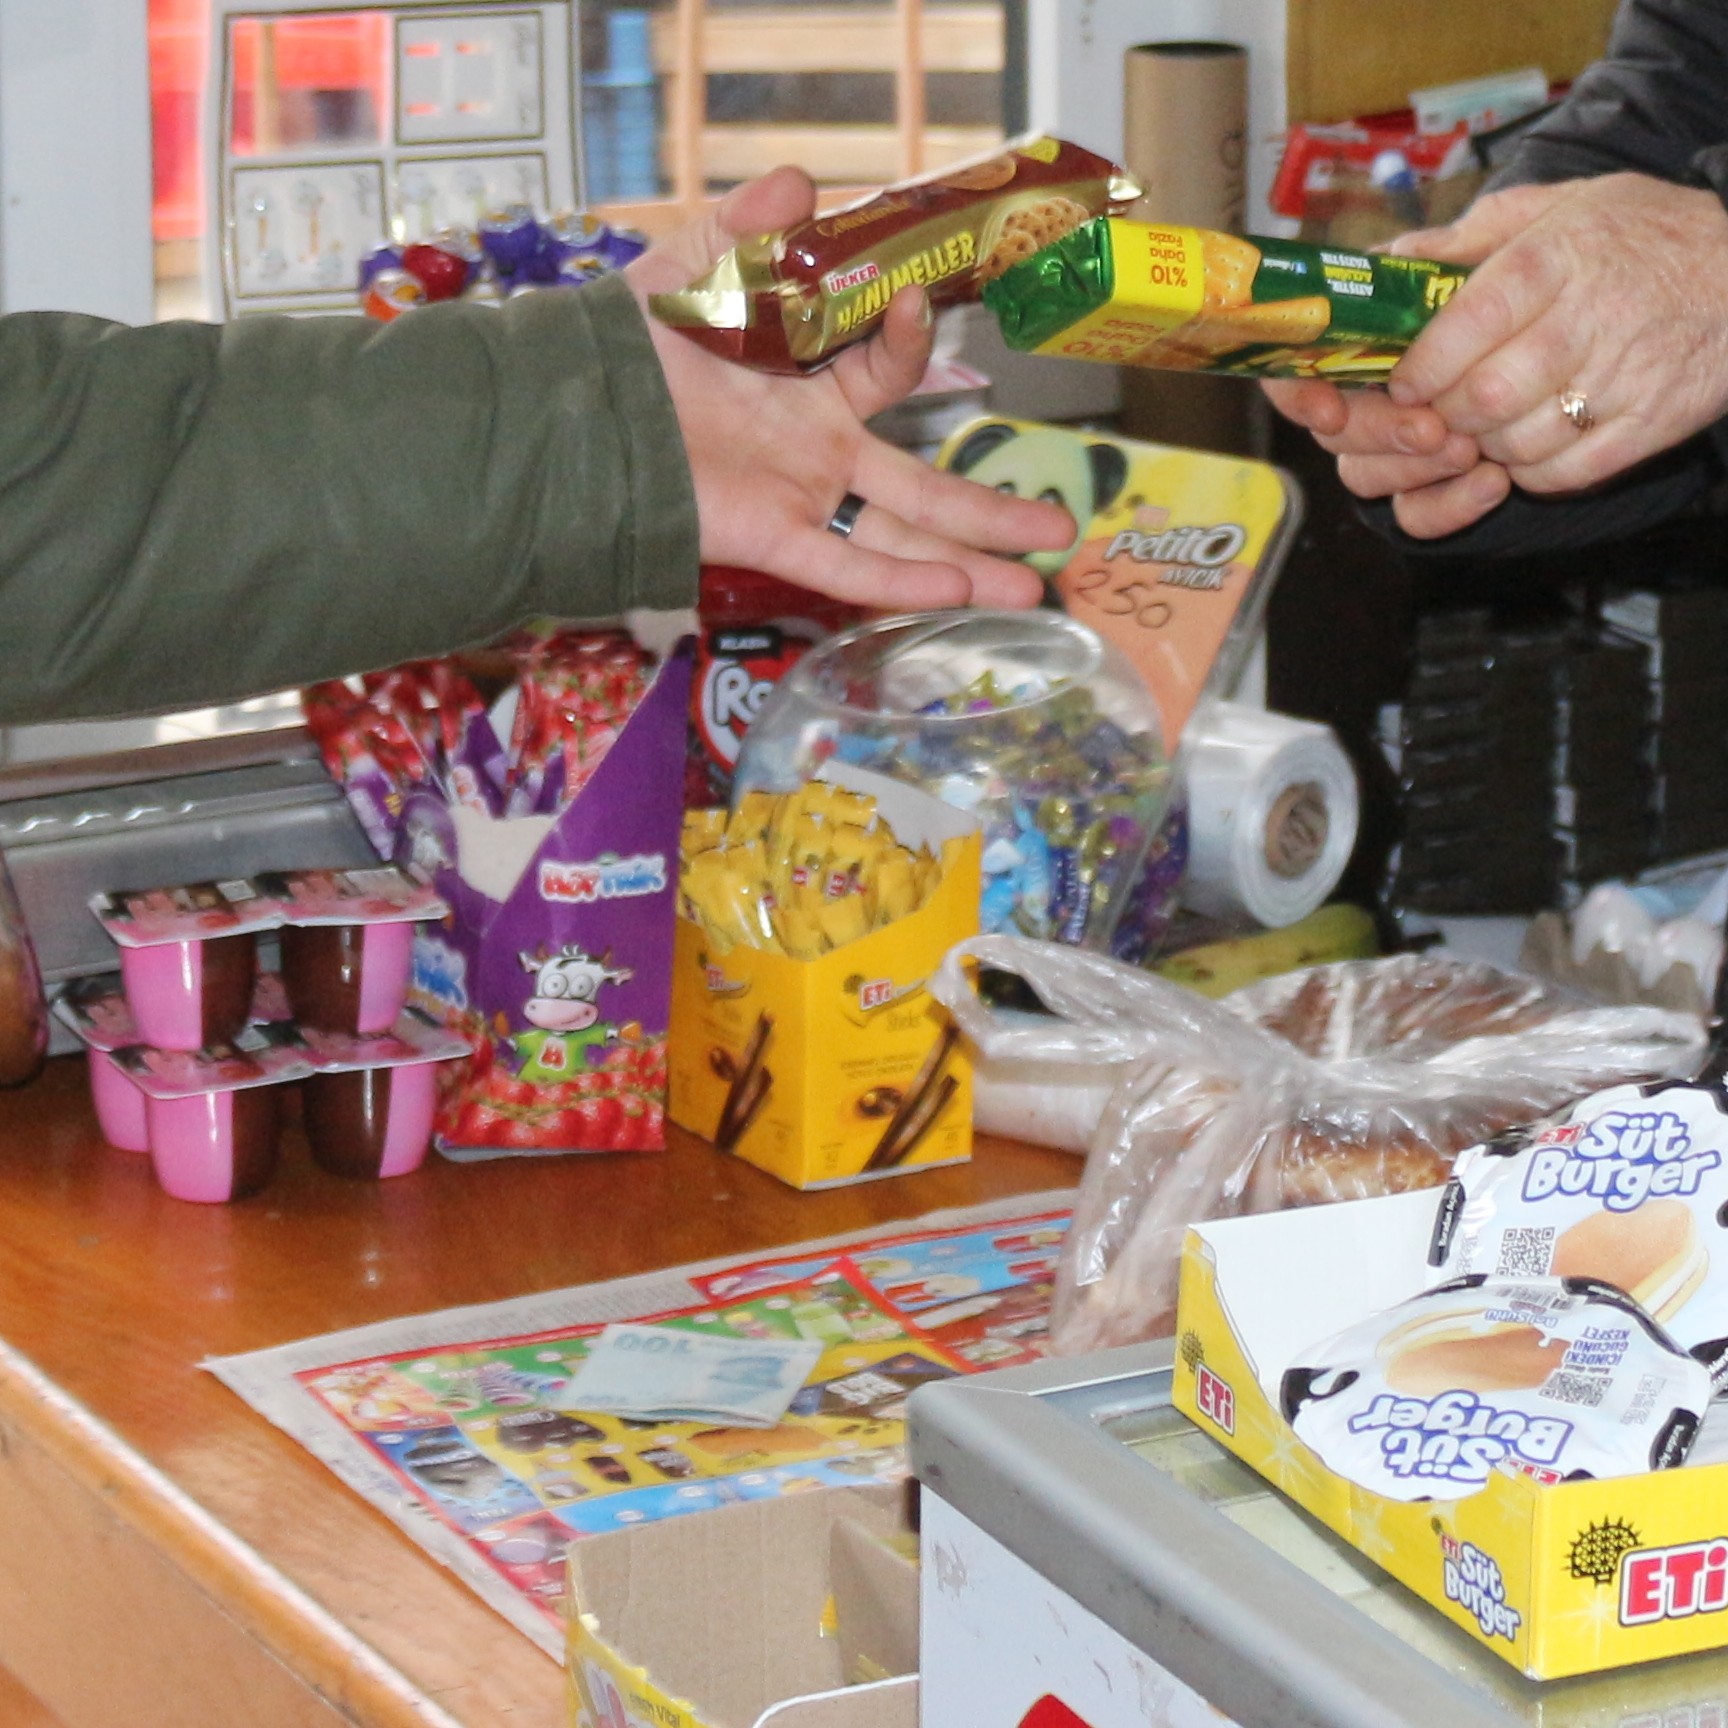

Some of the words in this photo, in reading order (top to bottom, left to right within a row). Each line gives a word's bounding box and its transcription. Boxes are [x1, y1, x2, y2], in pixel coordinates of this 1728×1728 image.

[827, 263, 880, 294] ÜLKER
[1149, 247, 1186, 264] Daha
[1580, 1111, 1692, 1165] Süt
[1522, 1145, 1722, 1213] Burger
[1194, 1363, 1237, 1437] ETi
[1350, 1390, 1573, 1464] Burger
[1444, 1558, 1521, 1642] Burger
[1461, 1542, 1505, 1601] Süt
